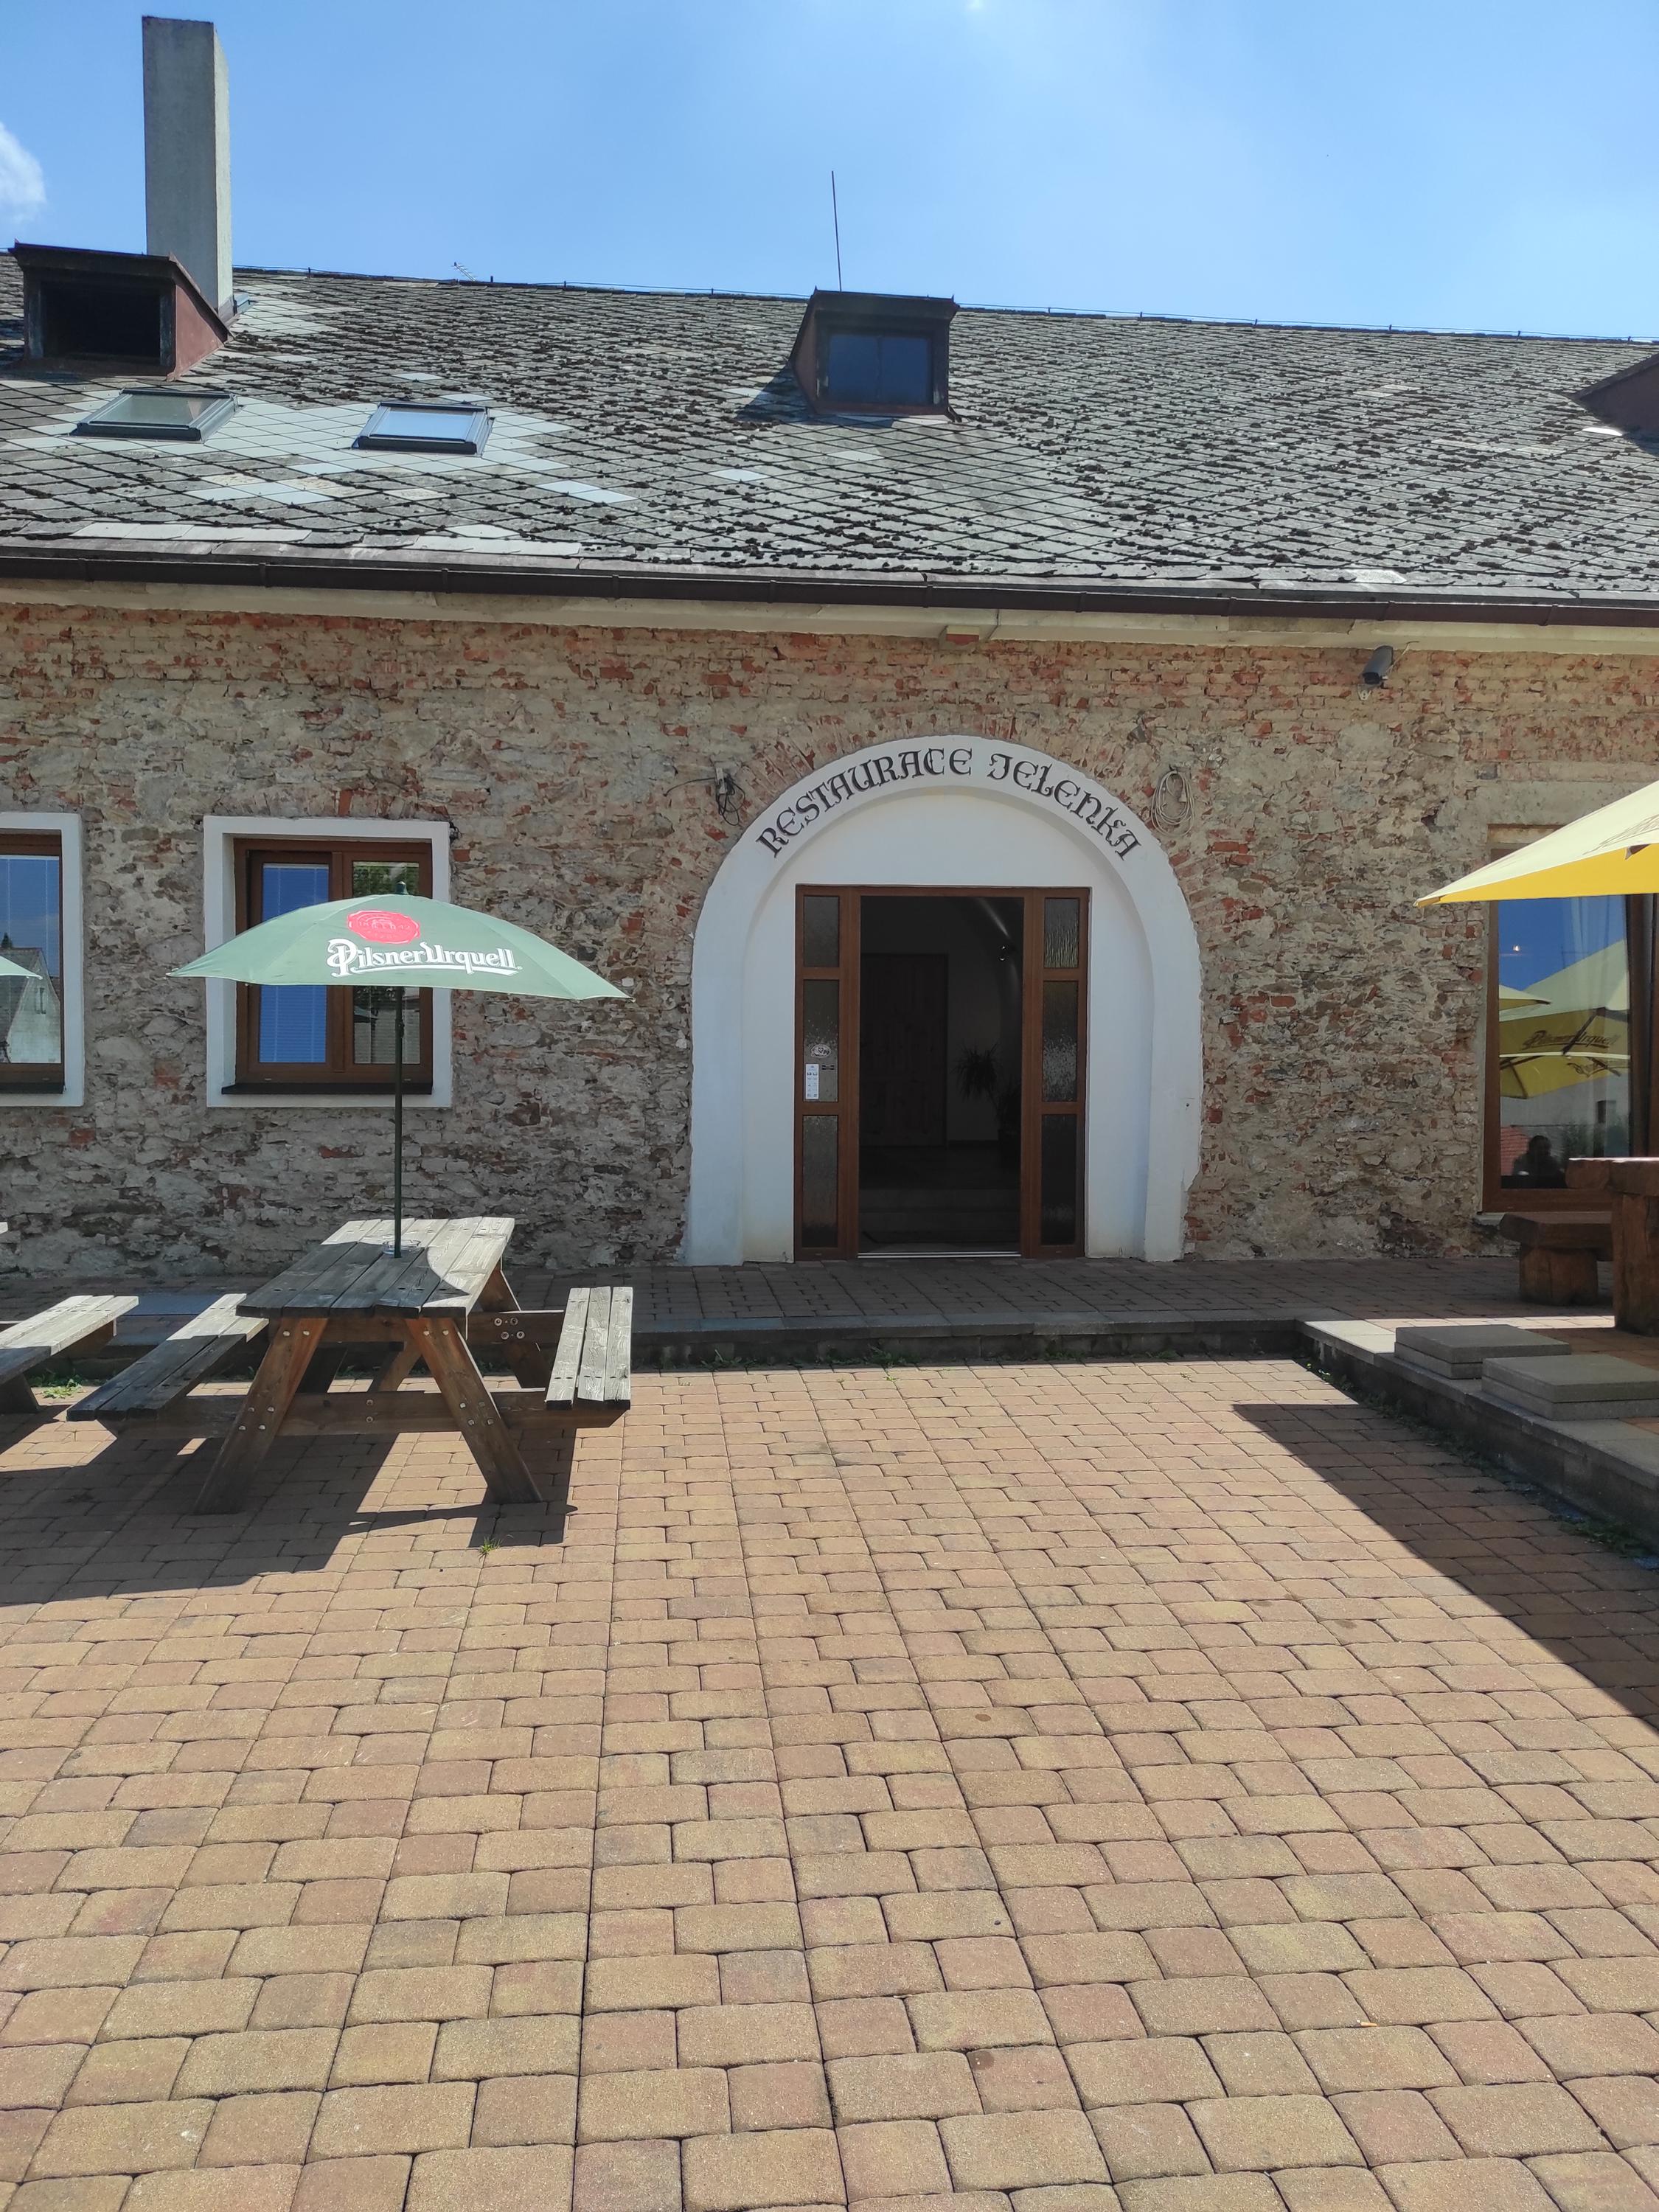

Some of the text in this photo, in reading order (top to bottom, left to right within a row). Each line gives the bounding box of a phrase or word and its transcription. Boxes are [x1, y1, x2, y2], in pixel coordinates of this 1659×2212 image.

[756, 747, 1142, 861] RESTAURACE JELENKA
[327, 938, 518, 978] Pilsner Urquell
